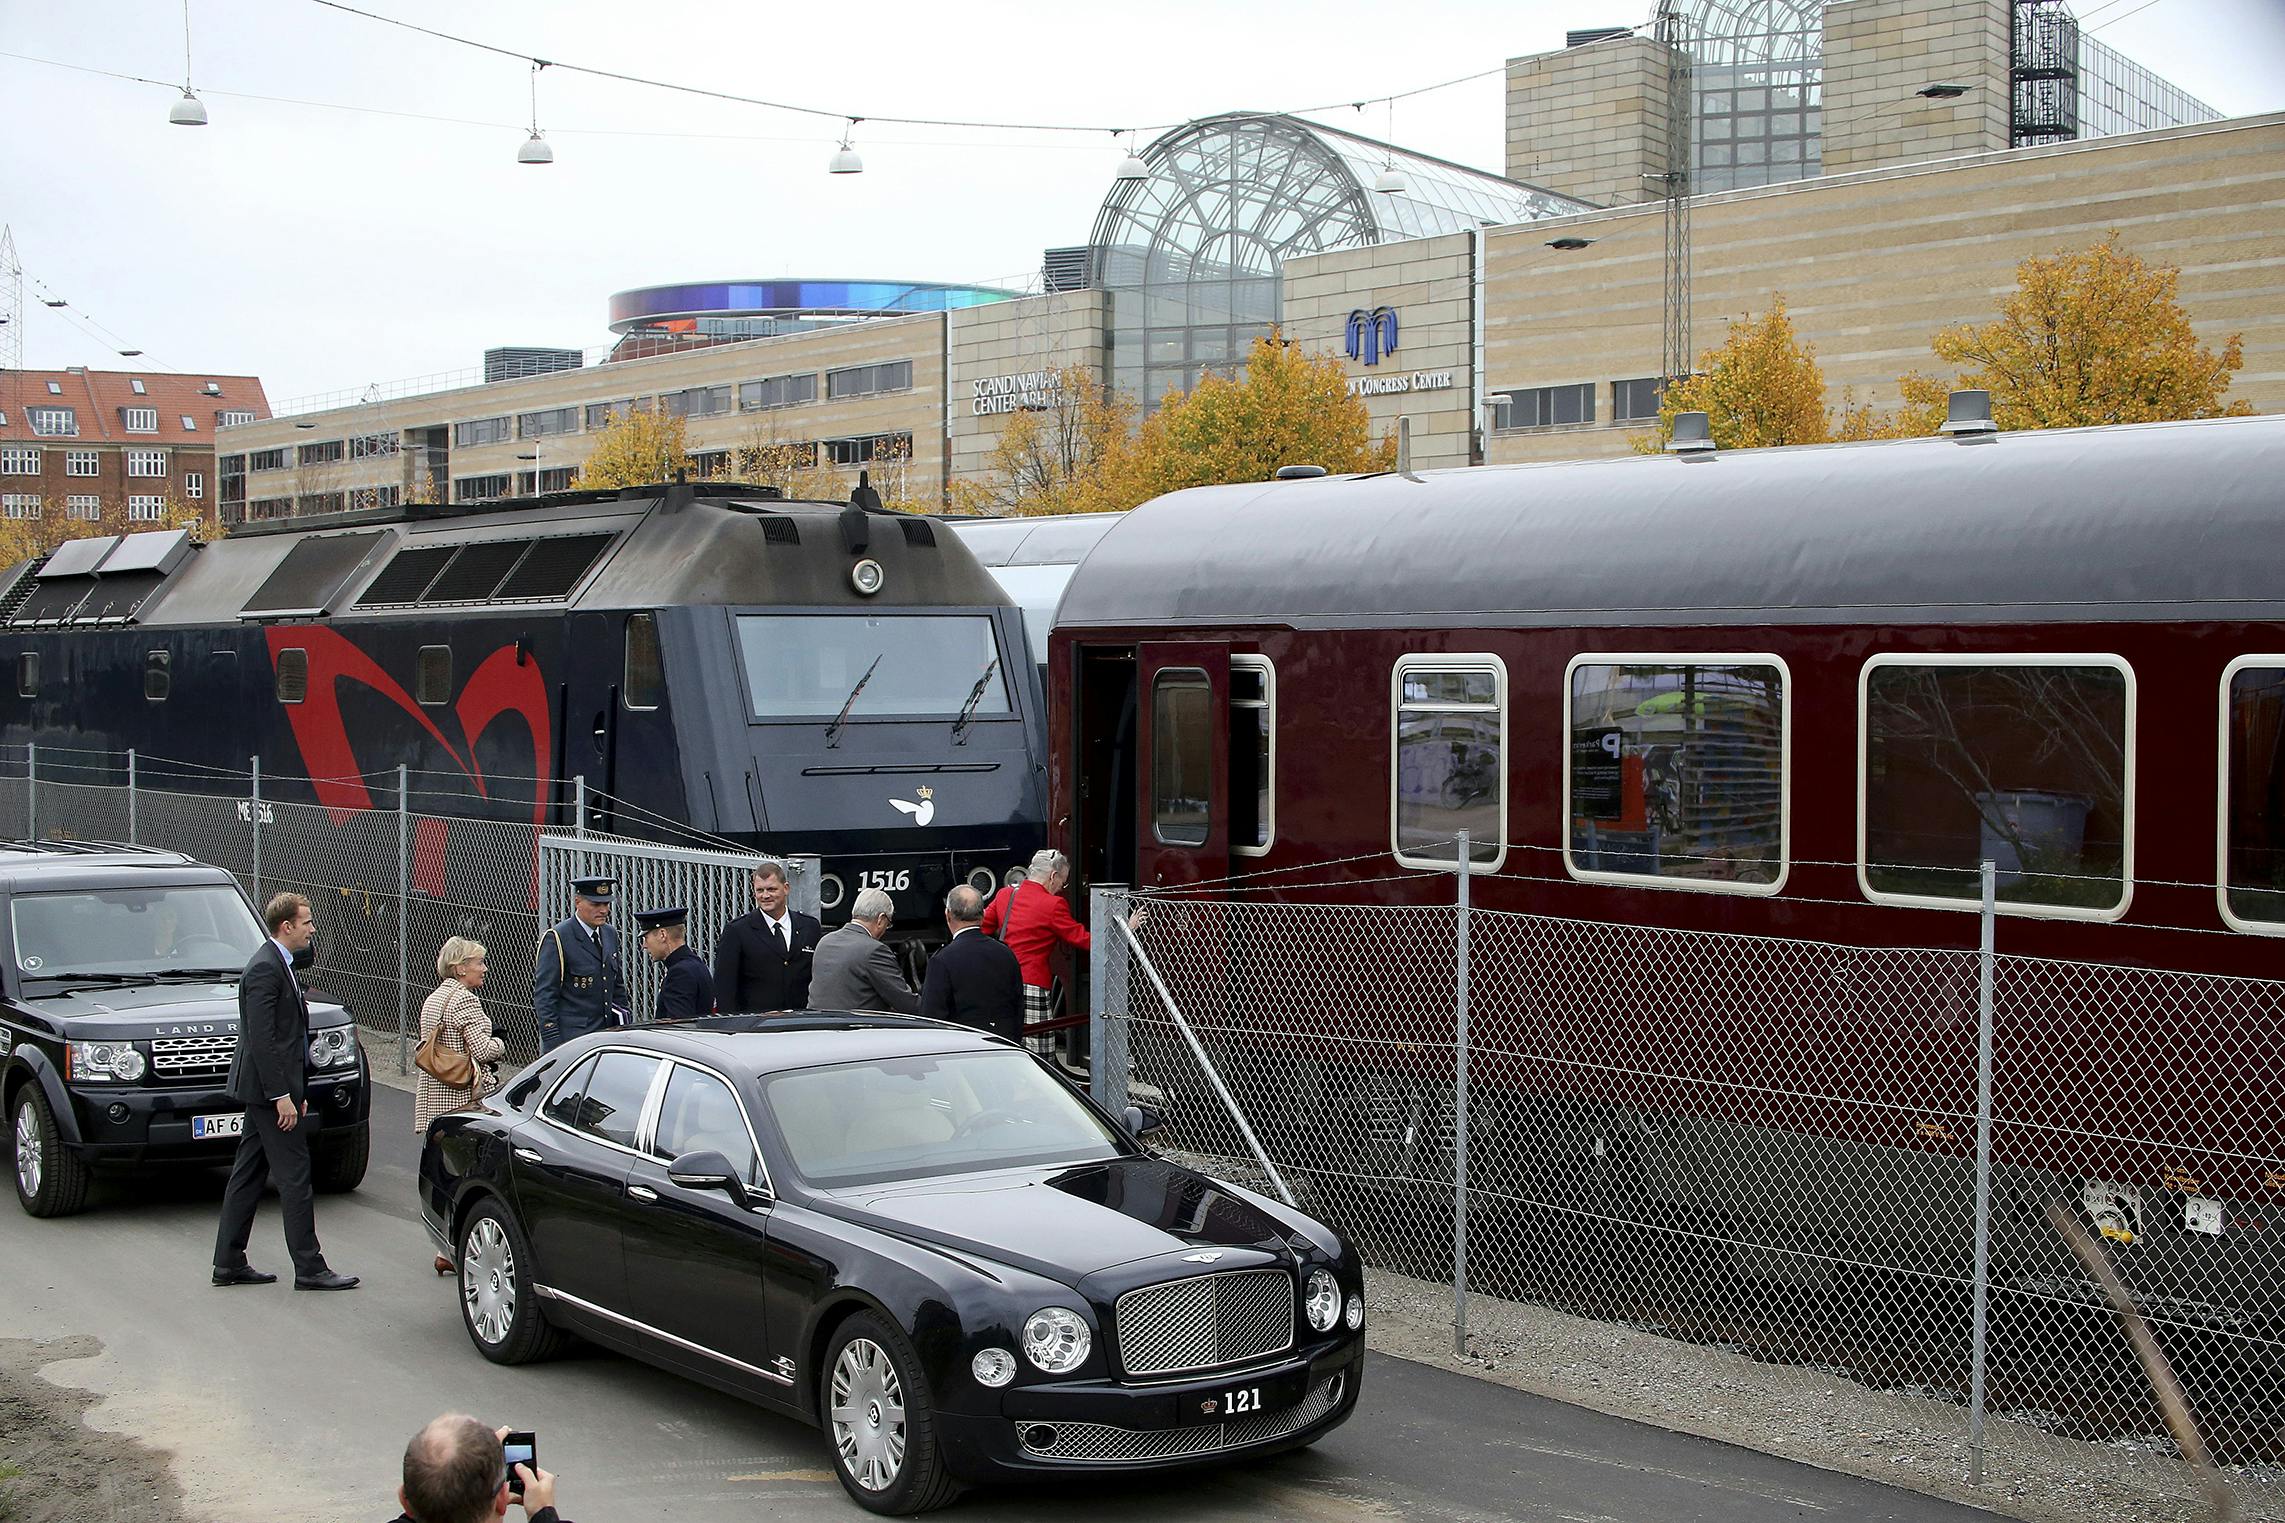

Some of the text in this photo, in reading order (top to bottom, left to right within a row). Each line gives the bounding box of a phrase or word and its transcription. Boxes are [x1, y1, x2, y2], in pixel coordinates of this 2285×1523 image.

[972, 393, 1017, 415] CENTER
[252, 803, 273, 823] 516
[857, 869, 910, 891] 1516
[155, 1024, 214, 1035] LAND
[206, 1117, 245, 1134] AF 6
[1224, 1388, 1262, 1415] 121
